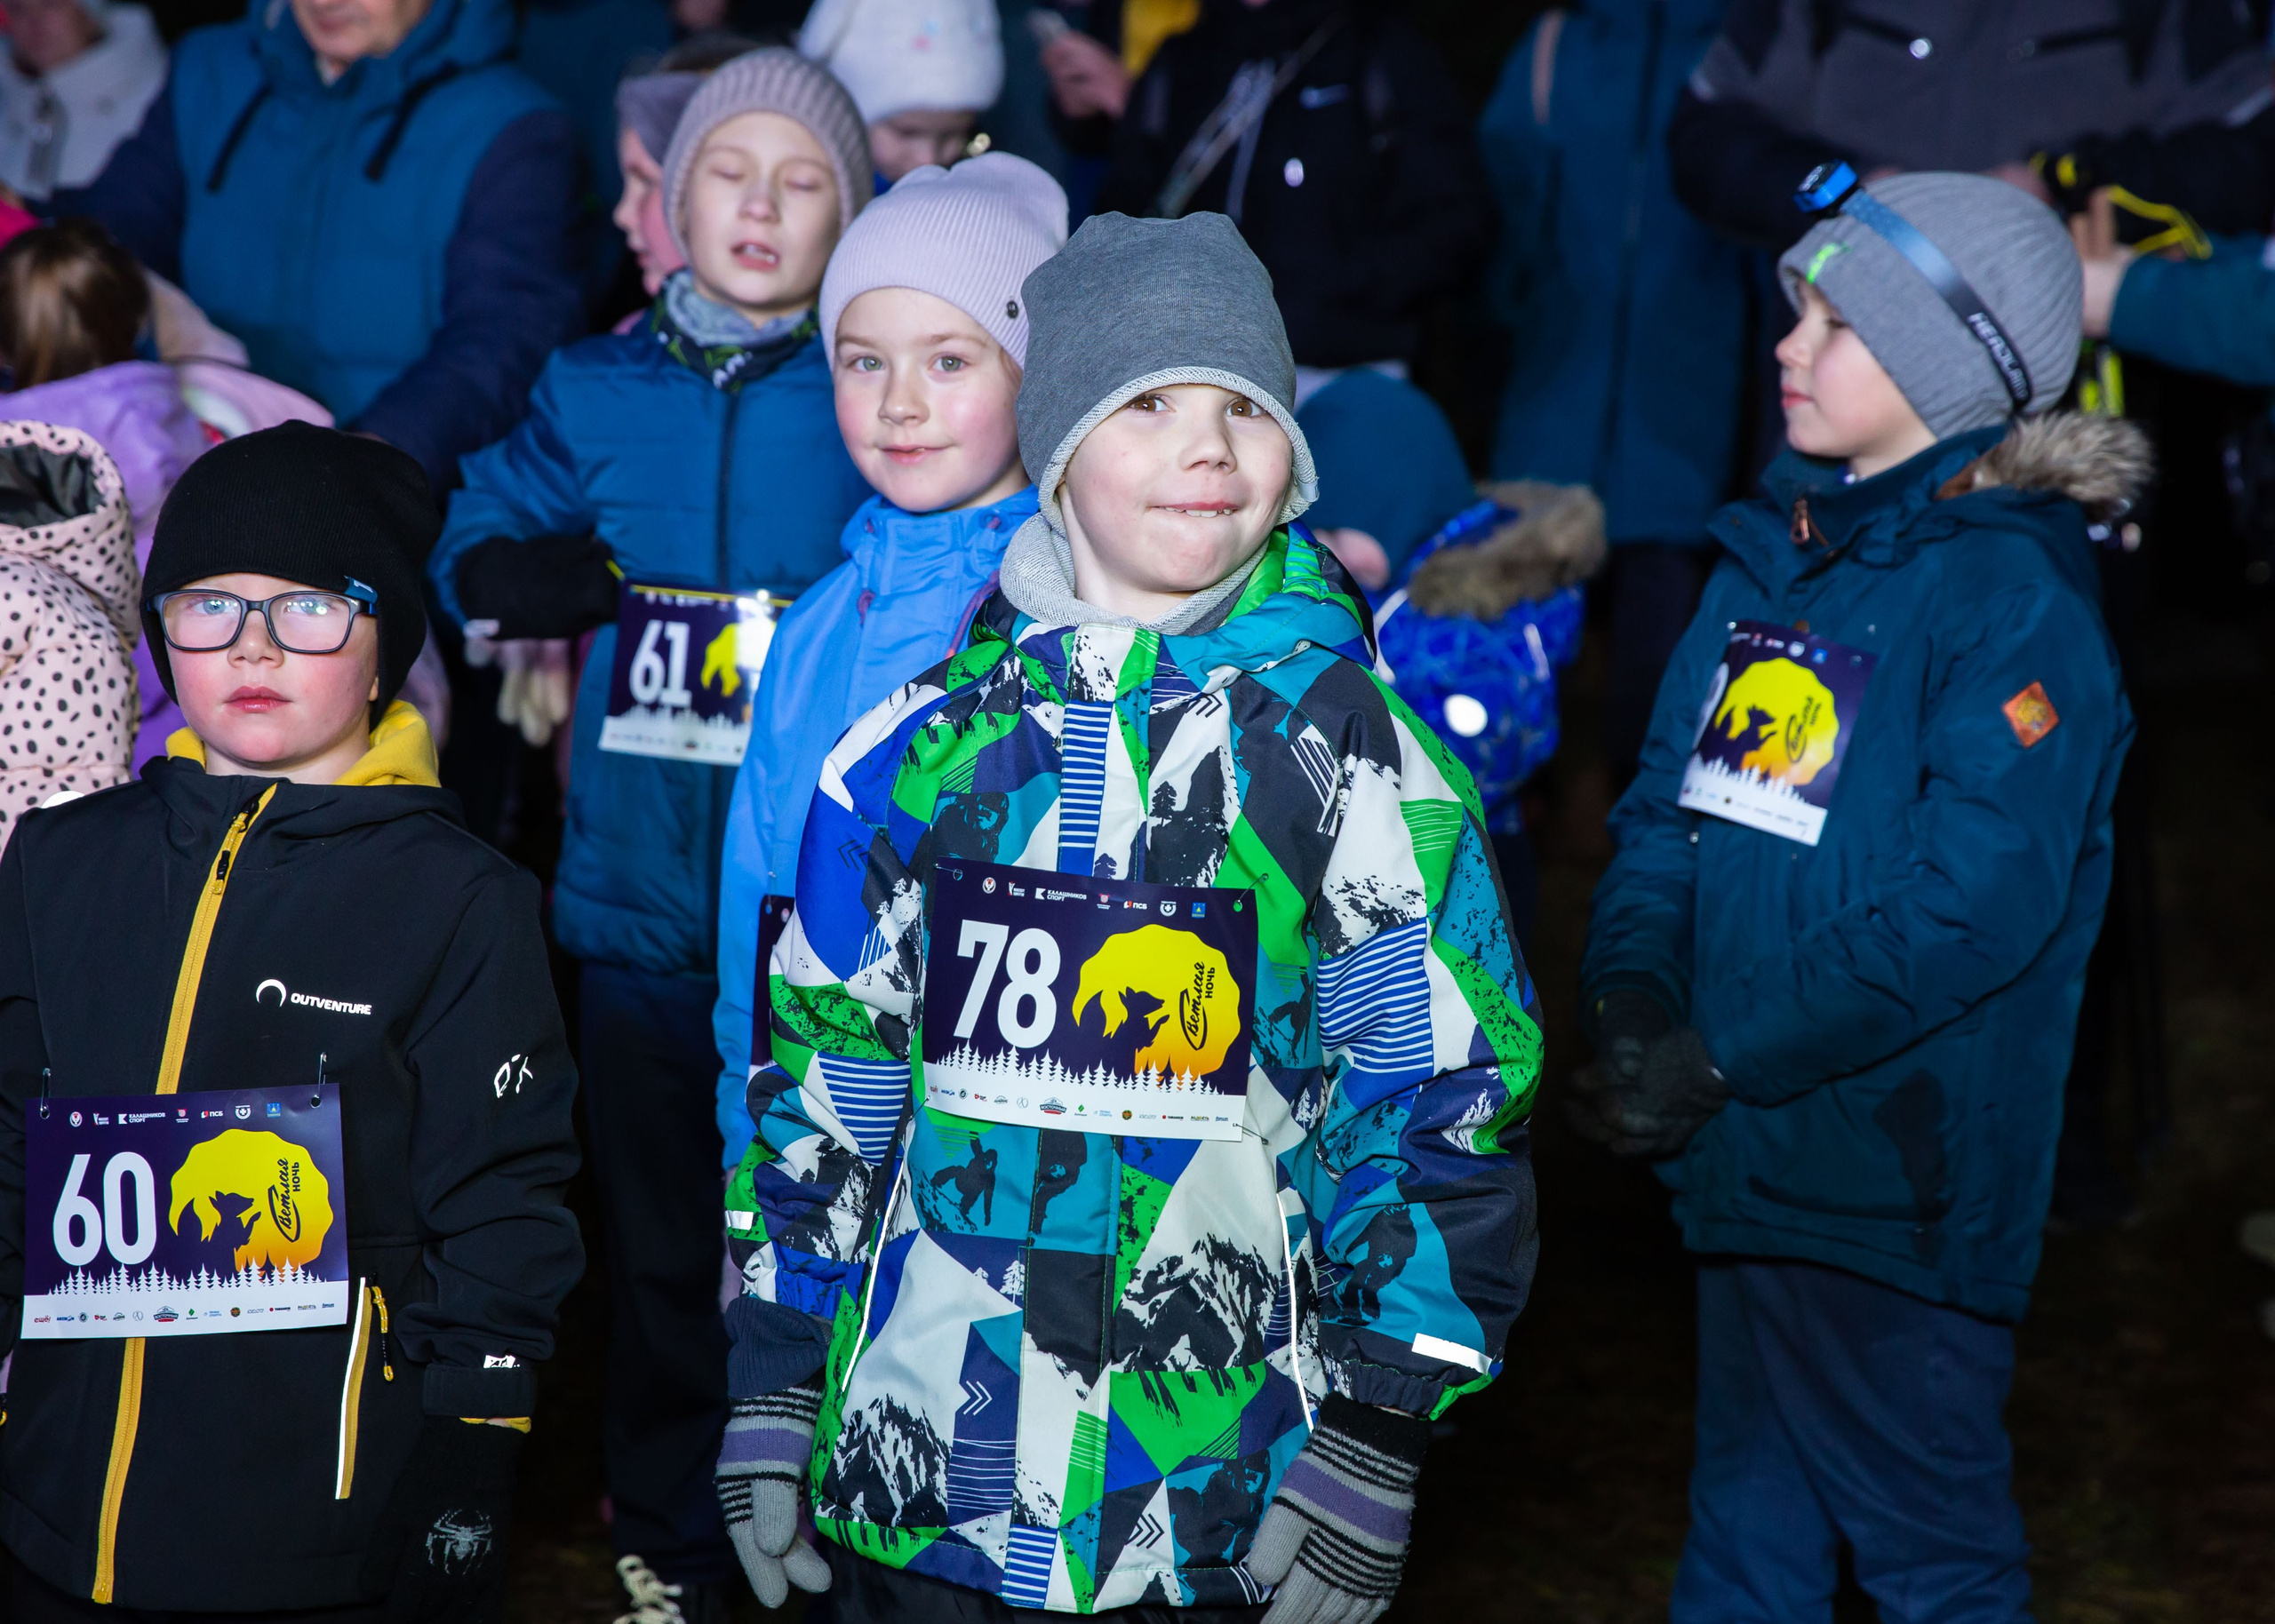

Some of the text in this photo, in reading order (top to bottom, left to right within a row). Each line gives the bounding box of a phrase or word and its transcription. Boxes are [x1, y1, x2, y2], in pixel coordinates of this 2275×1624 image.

[629, 618, 692, 705] 61
[1047, 889, 1087, 900] КАЛАШНИКОВ
[953, 919, 1061, 1049] 78
[1205, 967, 1216, 999] НОЧЬ
[290, 992, 372, 1015] OUTVENTURE
[291, 1161, 301, 1192] НОЧЬ
[52, 1151, 157, 1266] 60
